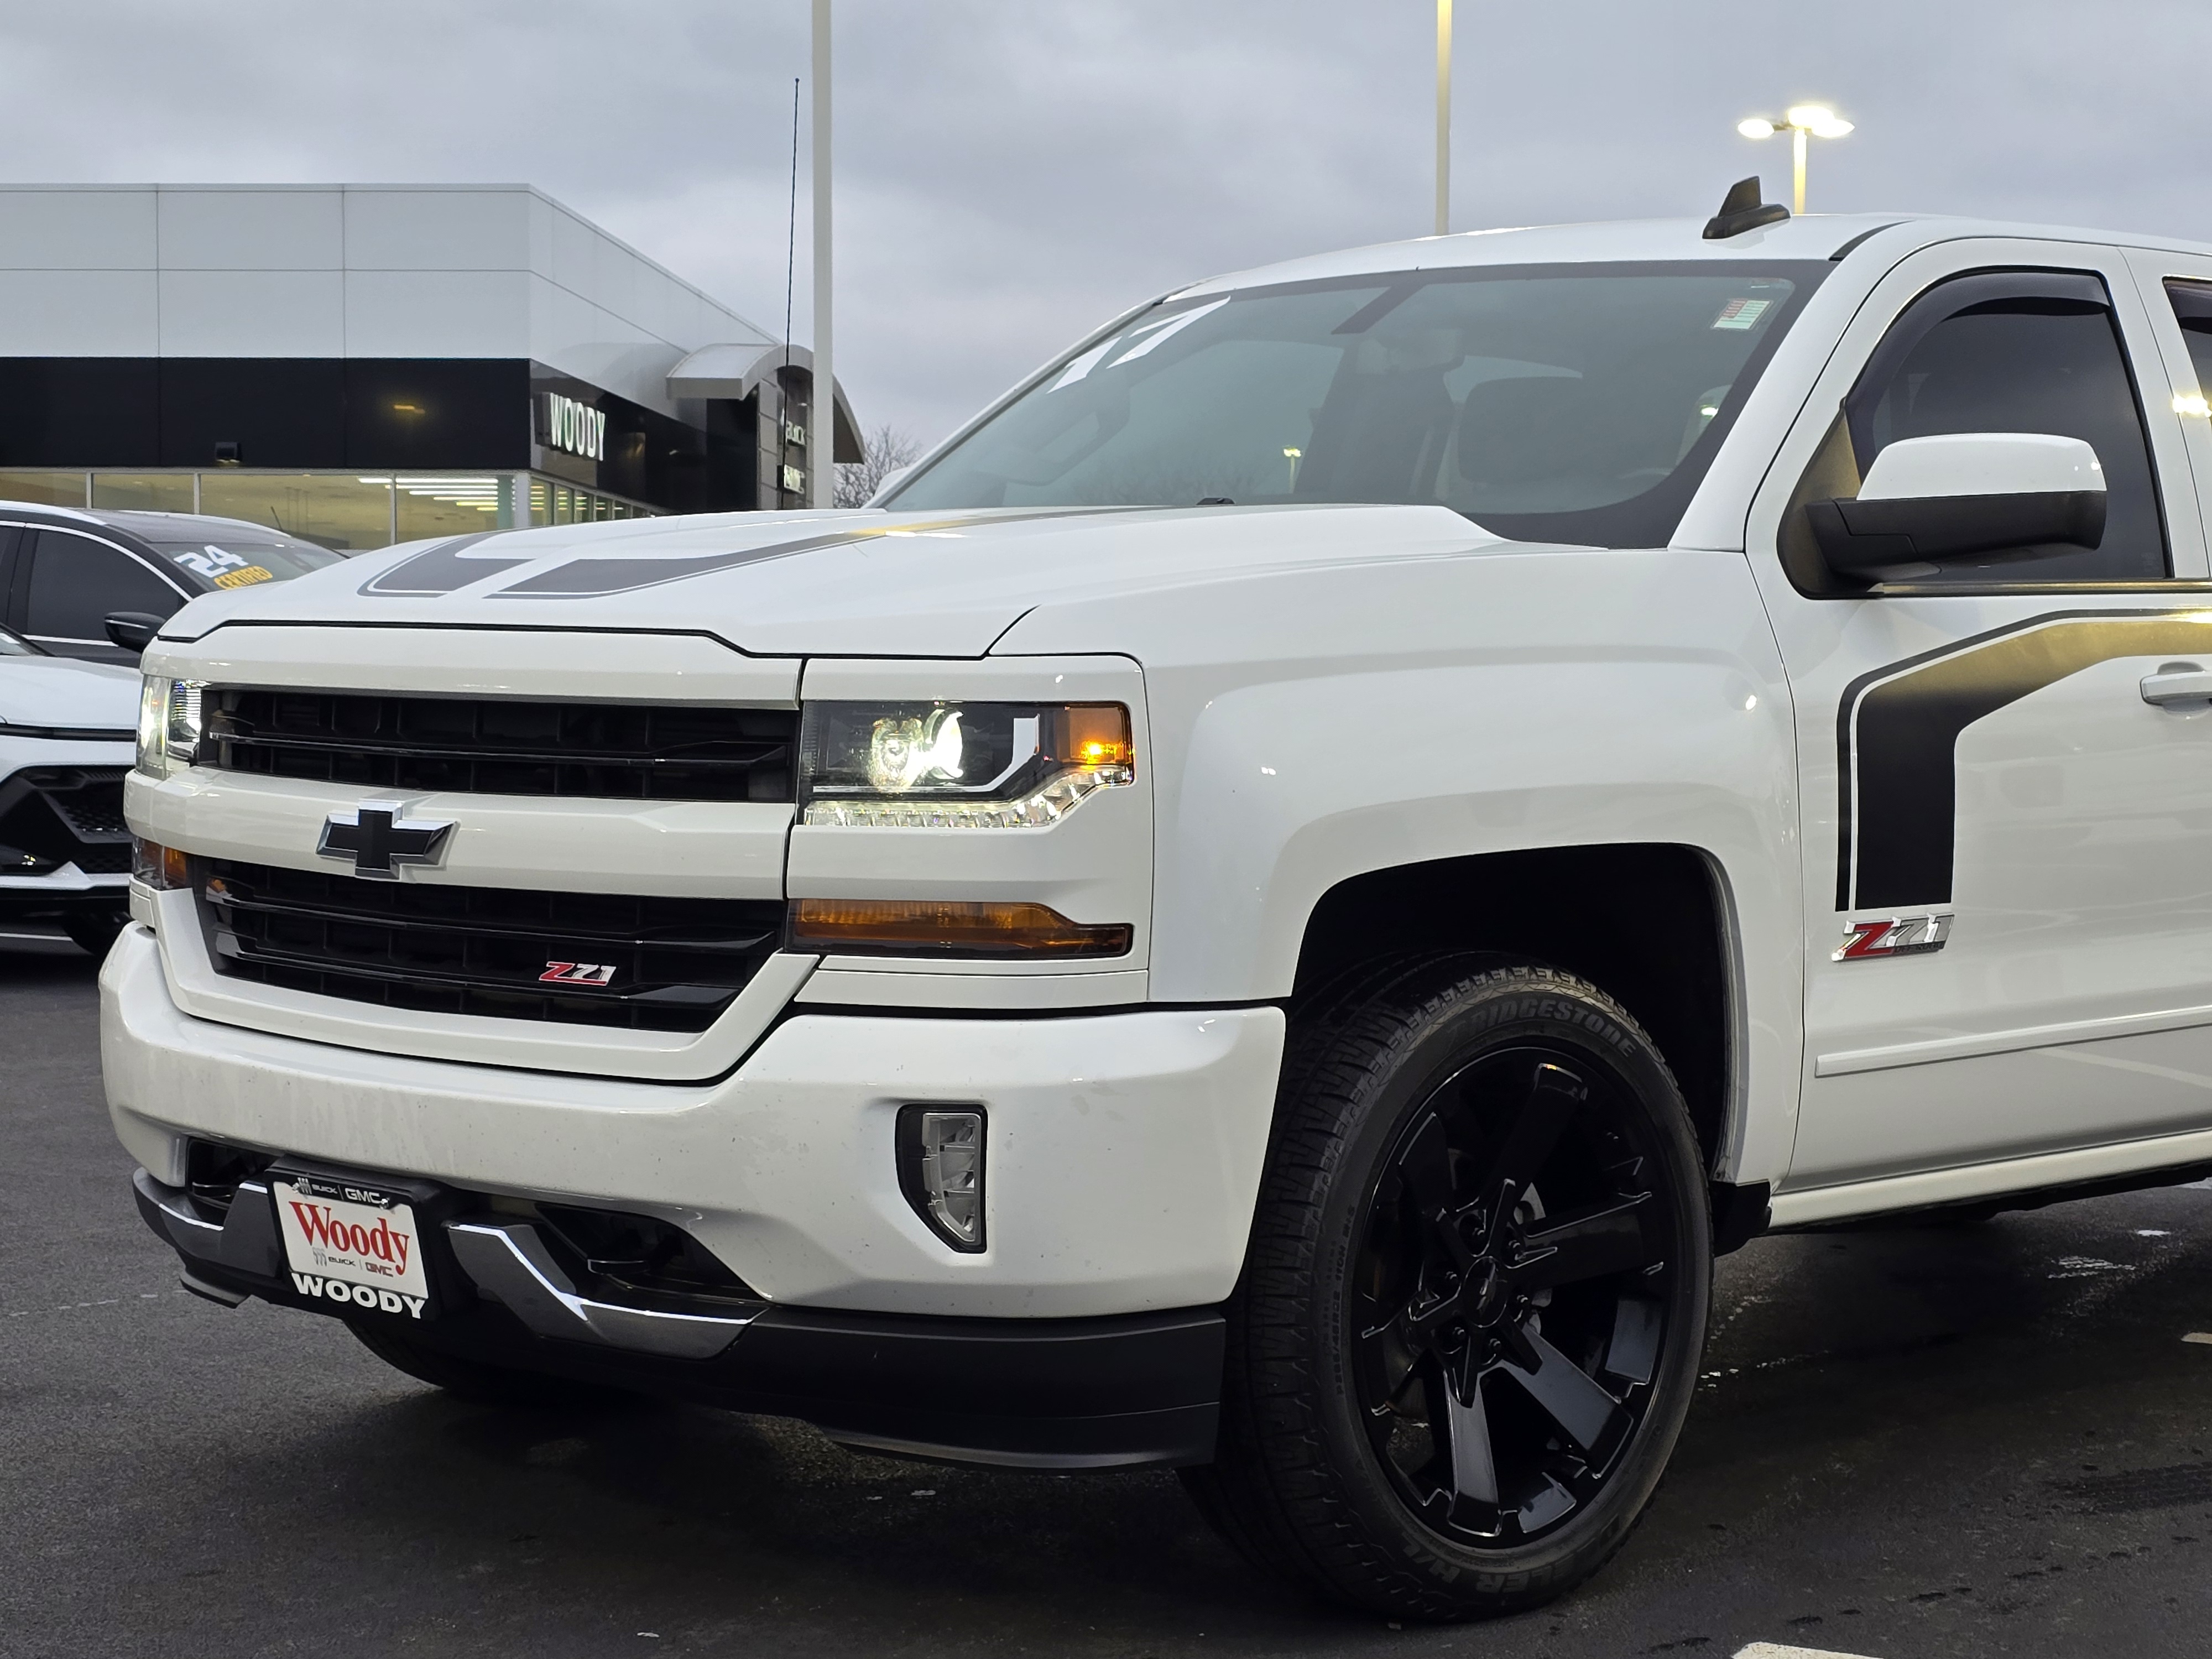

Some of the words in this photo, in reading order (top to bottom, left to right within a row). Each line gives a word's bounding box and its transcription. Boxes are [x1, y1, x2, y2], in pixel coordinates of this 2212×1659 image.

[550, 392, 606, 461] WOODY
[173, 545, 249, 578] 24
[214, 565, 273, 591] CERTIFIED
[1831, 912, 1955, 961] Z71
[538, 961, 617, 987] Z71
[311, 1184, 338, 1194] BUICK
[345, 1188, 380, 1203] GMC
[288, 1201, 410, 1276] Woody
[328, 1256, 356, 1267] BUICK
[365, 1261, 394, 1278] GMC
[291, 1272, 425, 1319] WOODY
[1475, 1514, 1619, 1594] DELER
